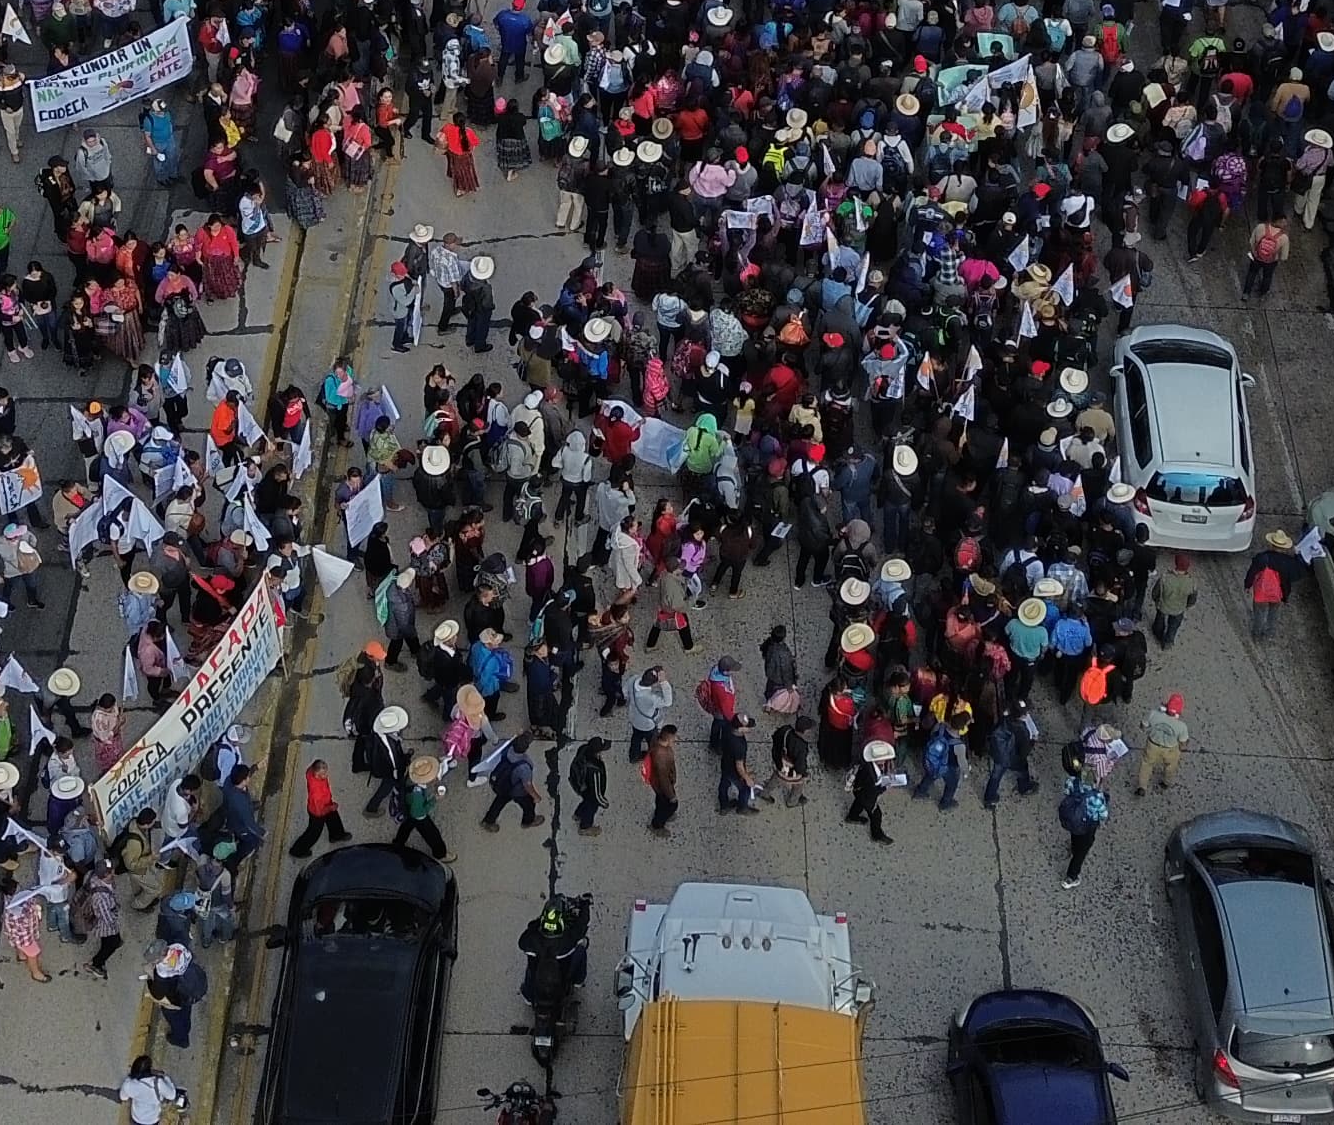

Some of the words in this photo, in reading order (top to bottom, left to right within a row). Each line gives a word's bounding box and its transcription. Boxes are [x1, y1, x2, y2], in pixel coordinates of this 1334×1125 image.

[72, 48, 129, 78] FUNDAR
[132, 37, 152, 56] UN
[38, 96, 90, 123] CODECA
[179, 608, 270, 733] PRESENTE
[107, 740, 169, 806] CODECA
[110, 783, 148, 827] ANTE
[150, 755, 171, 789] UN
[173, 701, 224, 766] ESTADO
